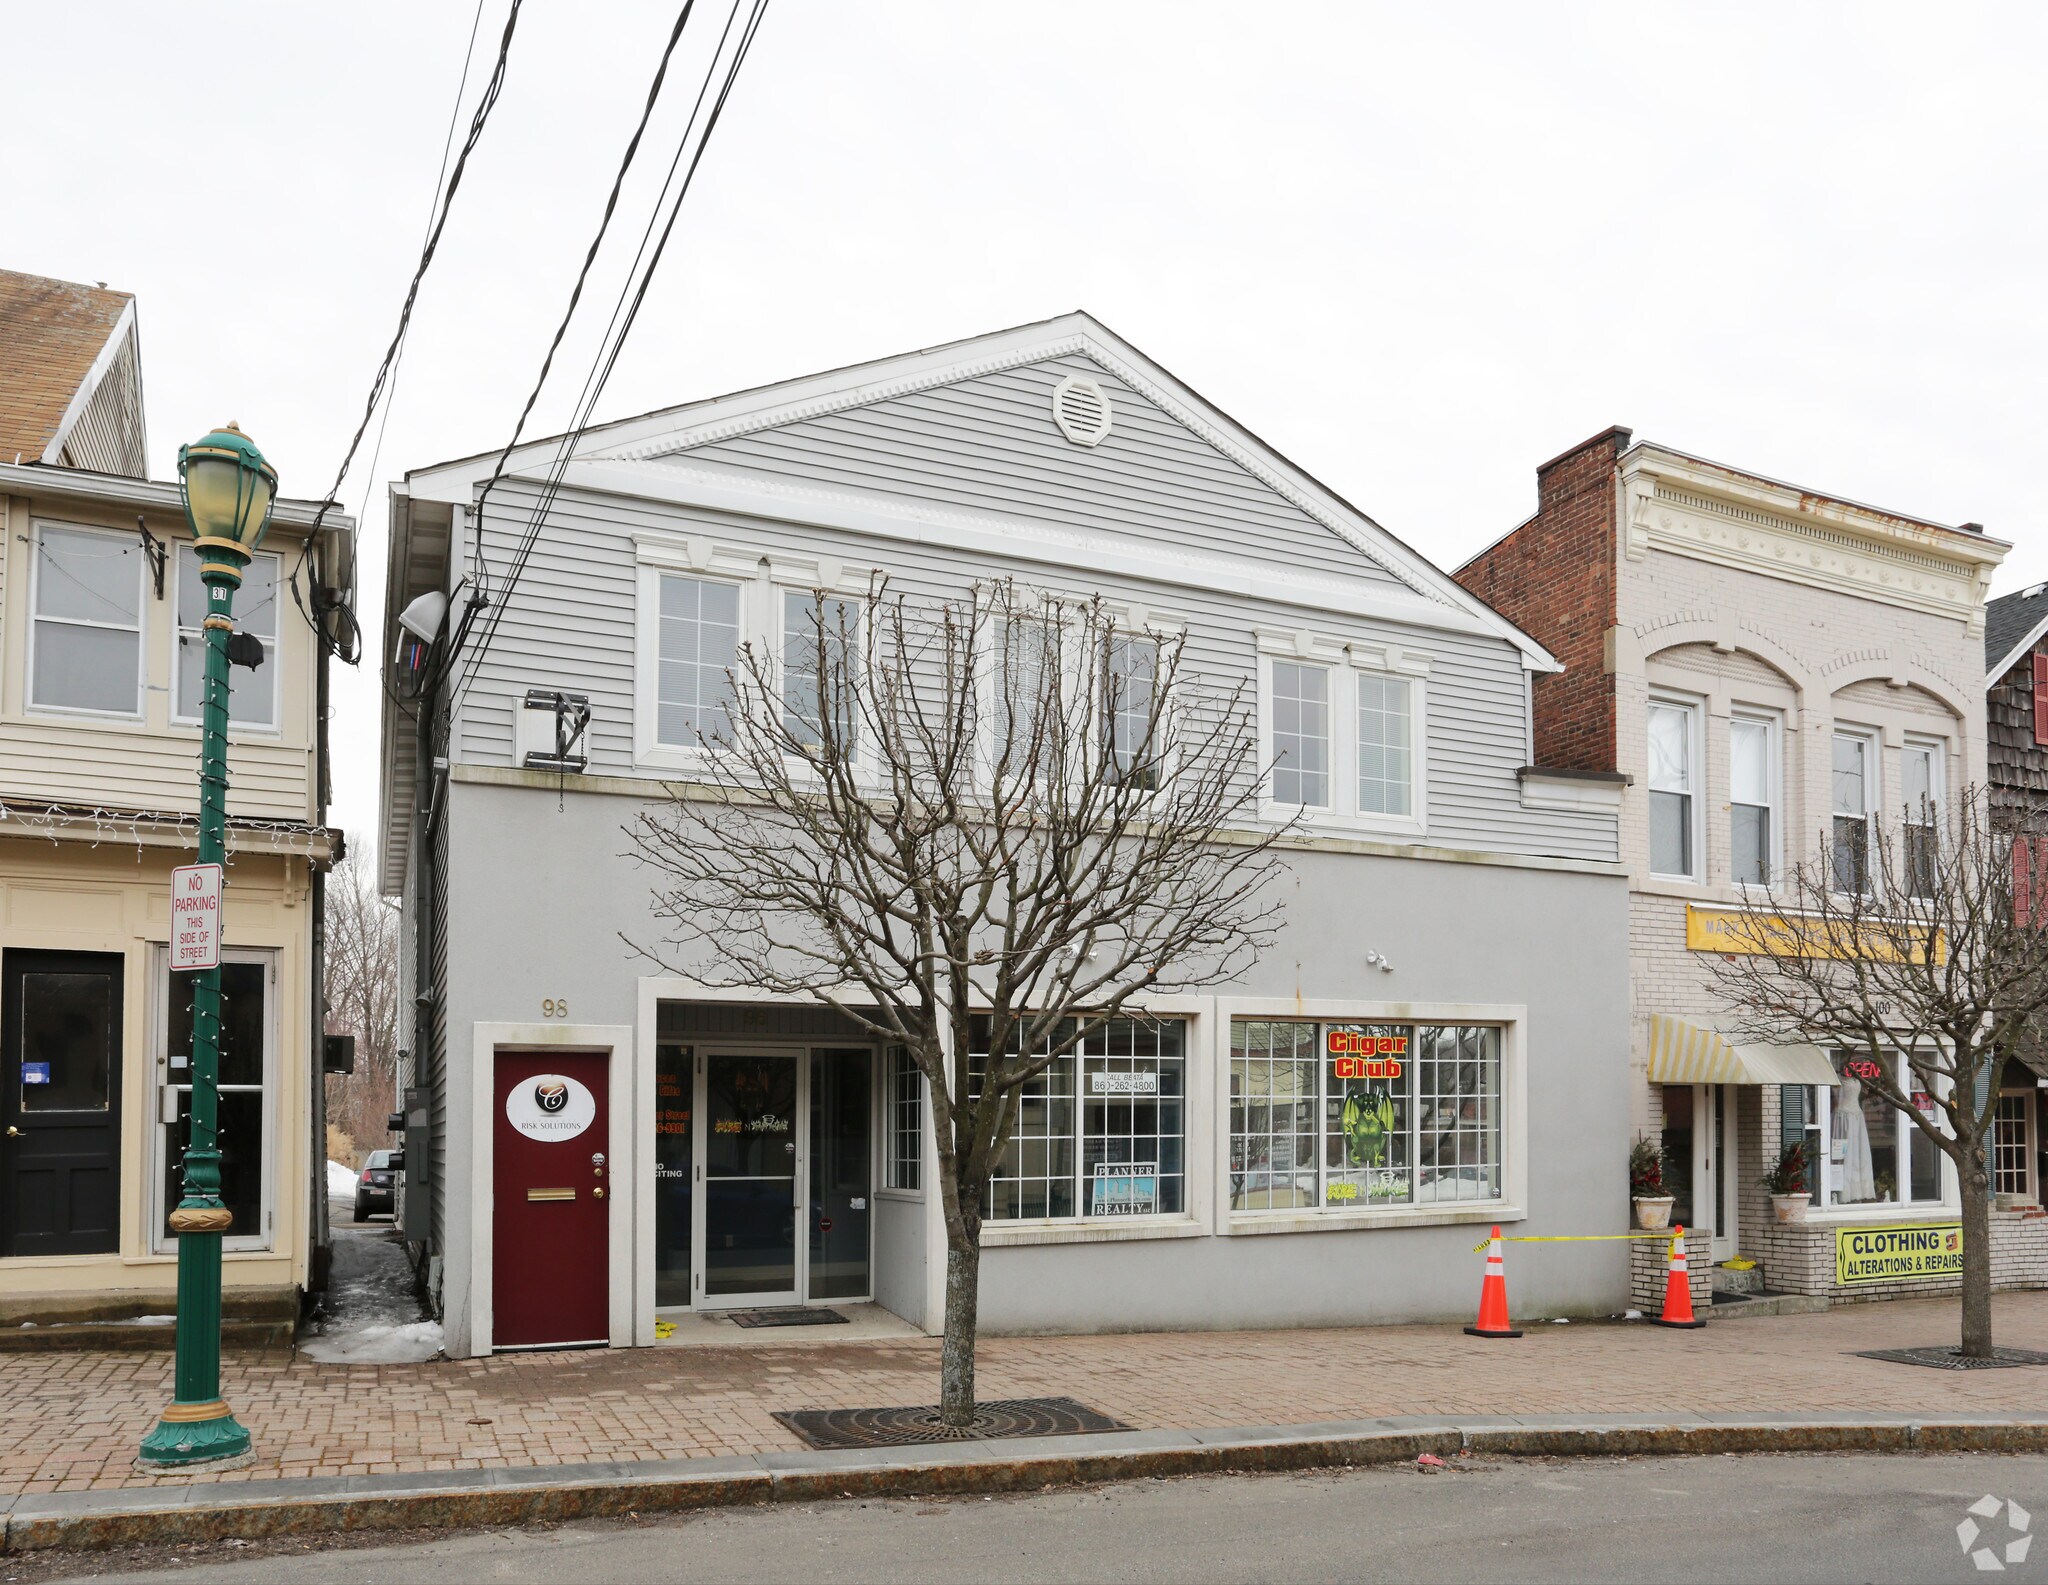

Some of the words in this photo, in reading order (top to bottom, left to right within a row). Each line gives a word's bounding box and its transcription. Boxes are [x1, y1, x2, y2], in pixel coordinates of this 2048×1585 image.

[188, 876, 203, 891] NO
[175, 895, 216, 912] PARKING
[187, 916, 203, 929] THIS
[180, 932, 196, 944] SIDE
[199, 931, 209, 943] OF
[180, 946, 208, 959] STREET
[542, 999, 568, 1017] 98
[1875, 1001, 1891, 1014] 100
[1328, 1031, 1408, 1057] Cigar
[1334, 1057, 1401, 1079] Club
[1845, 1062, 1881, 1078] OPEN
[521, 1122, 538, 1130] RISK
[540, 1122, 581, 1130] SOLUTIONS
[1098, 1166, 1153, 1176] PLANNER
[1096, 1203, 1144, 1214] REALTY
[1852, 1232, 1940, 1254] CLOTHING
[1847, 1257, 1913, 1276] ALTERATIONS
[1915, 1256, 1922, 1270] &
[1925, 1254, 1963, 1270] REPAIRS
